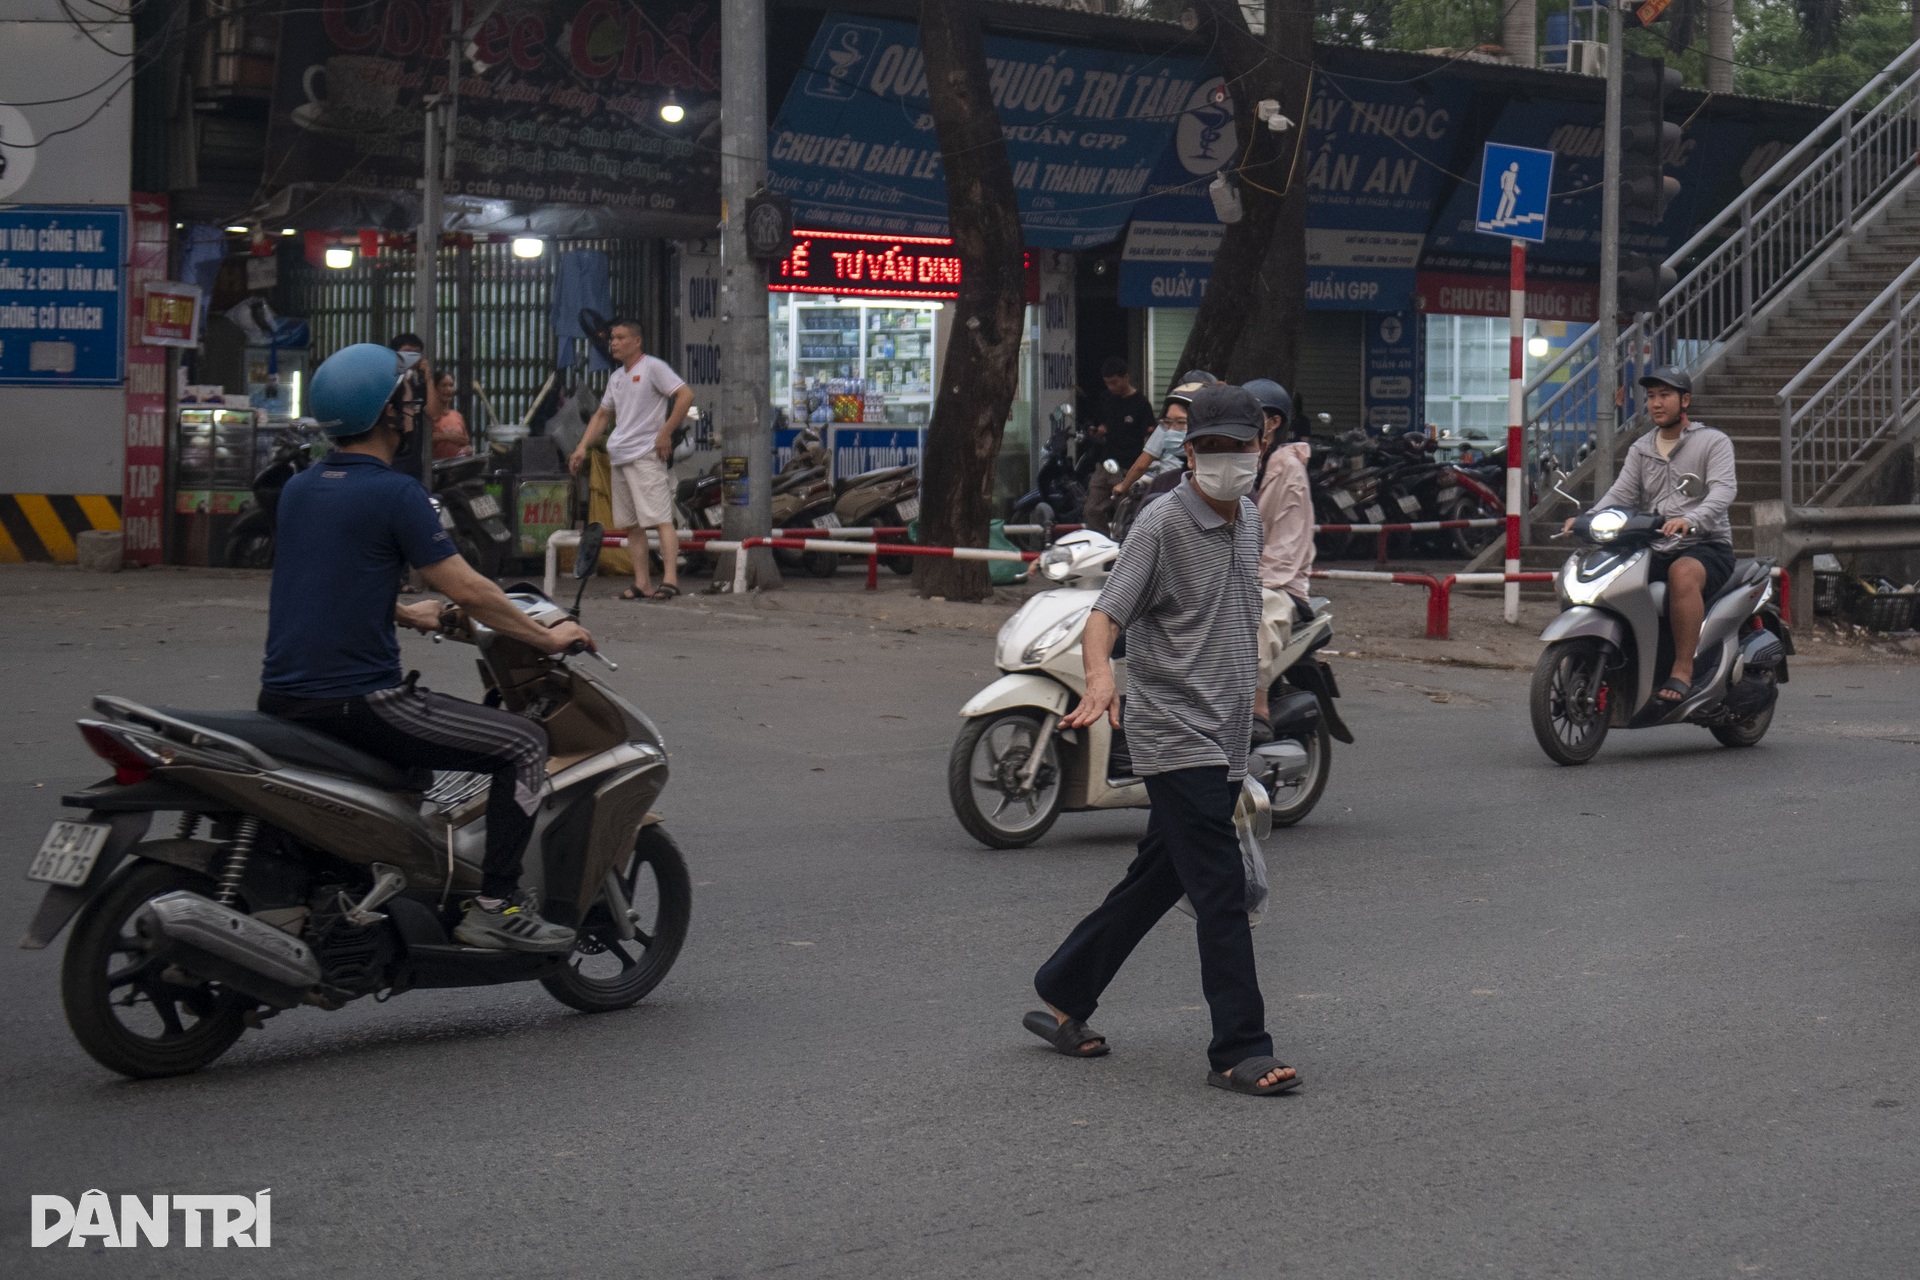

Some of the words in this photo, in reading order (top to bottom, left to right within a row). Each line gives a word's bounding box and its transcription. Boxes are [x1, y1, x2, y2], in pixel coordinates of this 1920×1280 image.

[321, 0, 546, 70] Cofee
[985, 50, 1074, 114] HUỐC
[1073, 65, 1135, 119] TRÍ
[1125, 68, 1195, 122] TÂM
[1348, 97, 1449, 140] THUỐC
[772, 131, 866, 169] CHUYÊN
[863, 140, 914, 175] BÁN
[1079, 132, 1127, 149] GPP
[1362, 156, 1418, 194] AN
[10, 223, 36, 252] VÀO
[38, 220, 75, 252] CỔNG
[26, 267, 36, 290] 2
[38, 267, 65, 291] CHU
[66, 263, 94, 291] VĂN
[831, 250, 865, 280] TƯ
[866, 245, 914, 282] VẤN
[1305, 271, 1345, 300] HUẨN
[1348, 281, 1379, 300] GPP
[1439, 285, 1508, 312] CHUYÊN
[1525, 287, 1566, 317] HUỐC
[0, 301, 36, 329] HÔNG
[38, 301, 57, 329] CÓ
[59, 301, 104, 330] KHÁCH
[686, 330, 720, 385] THUỐC
[128, 465, 161, 506] TẠP
